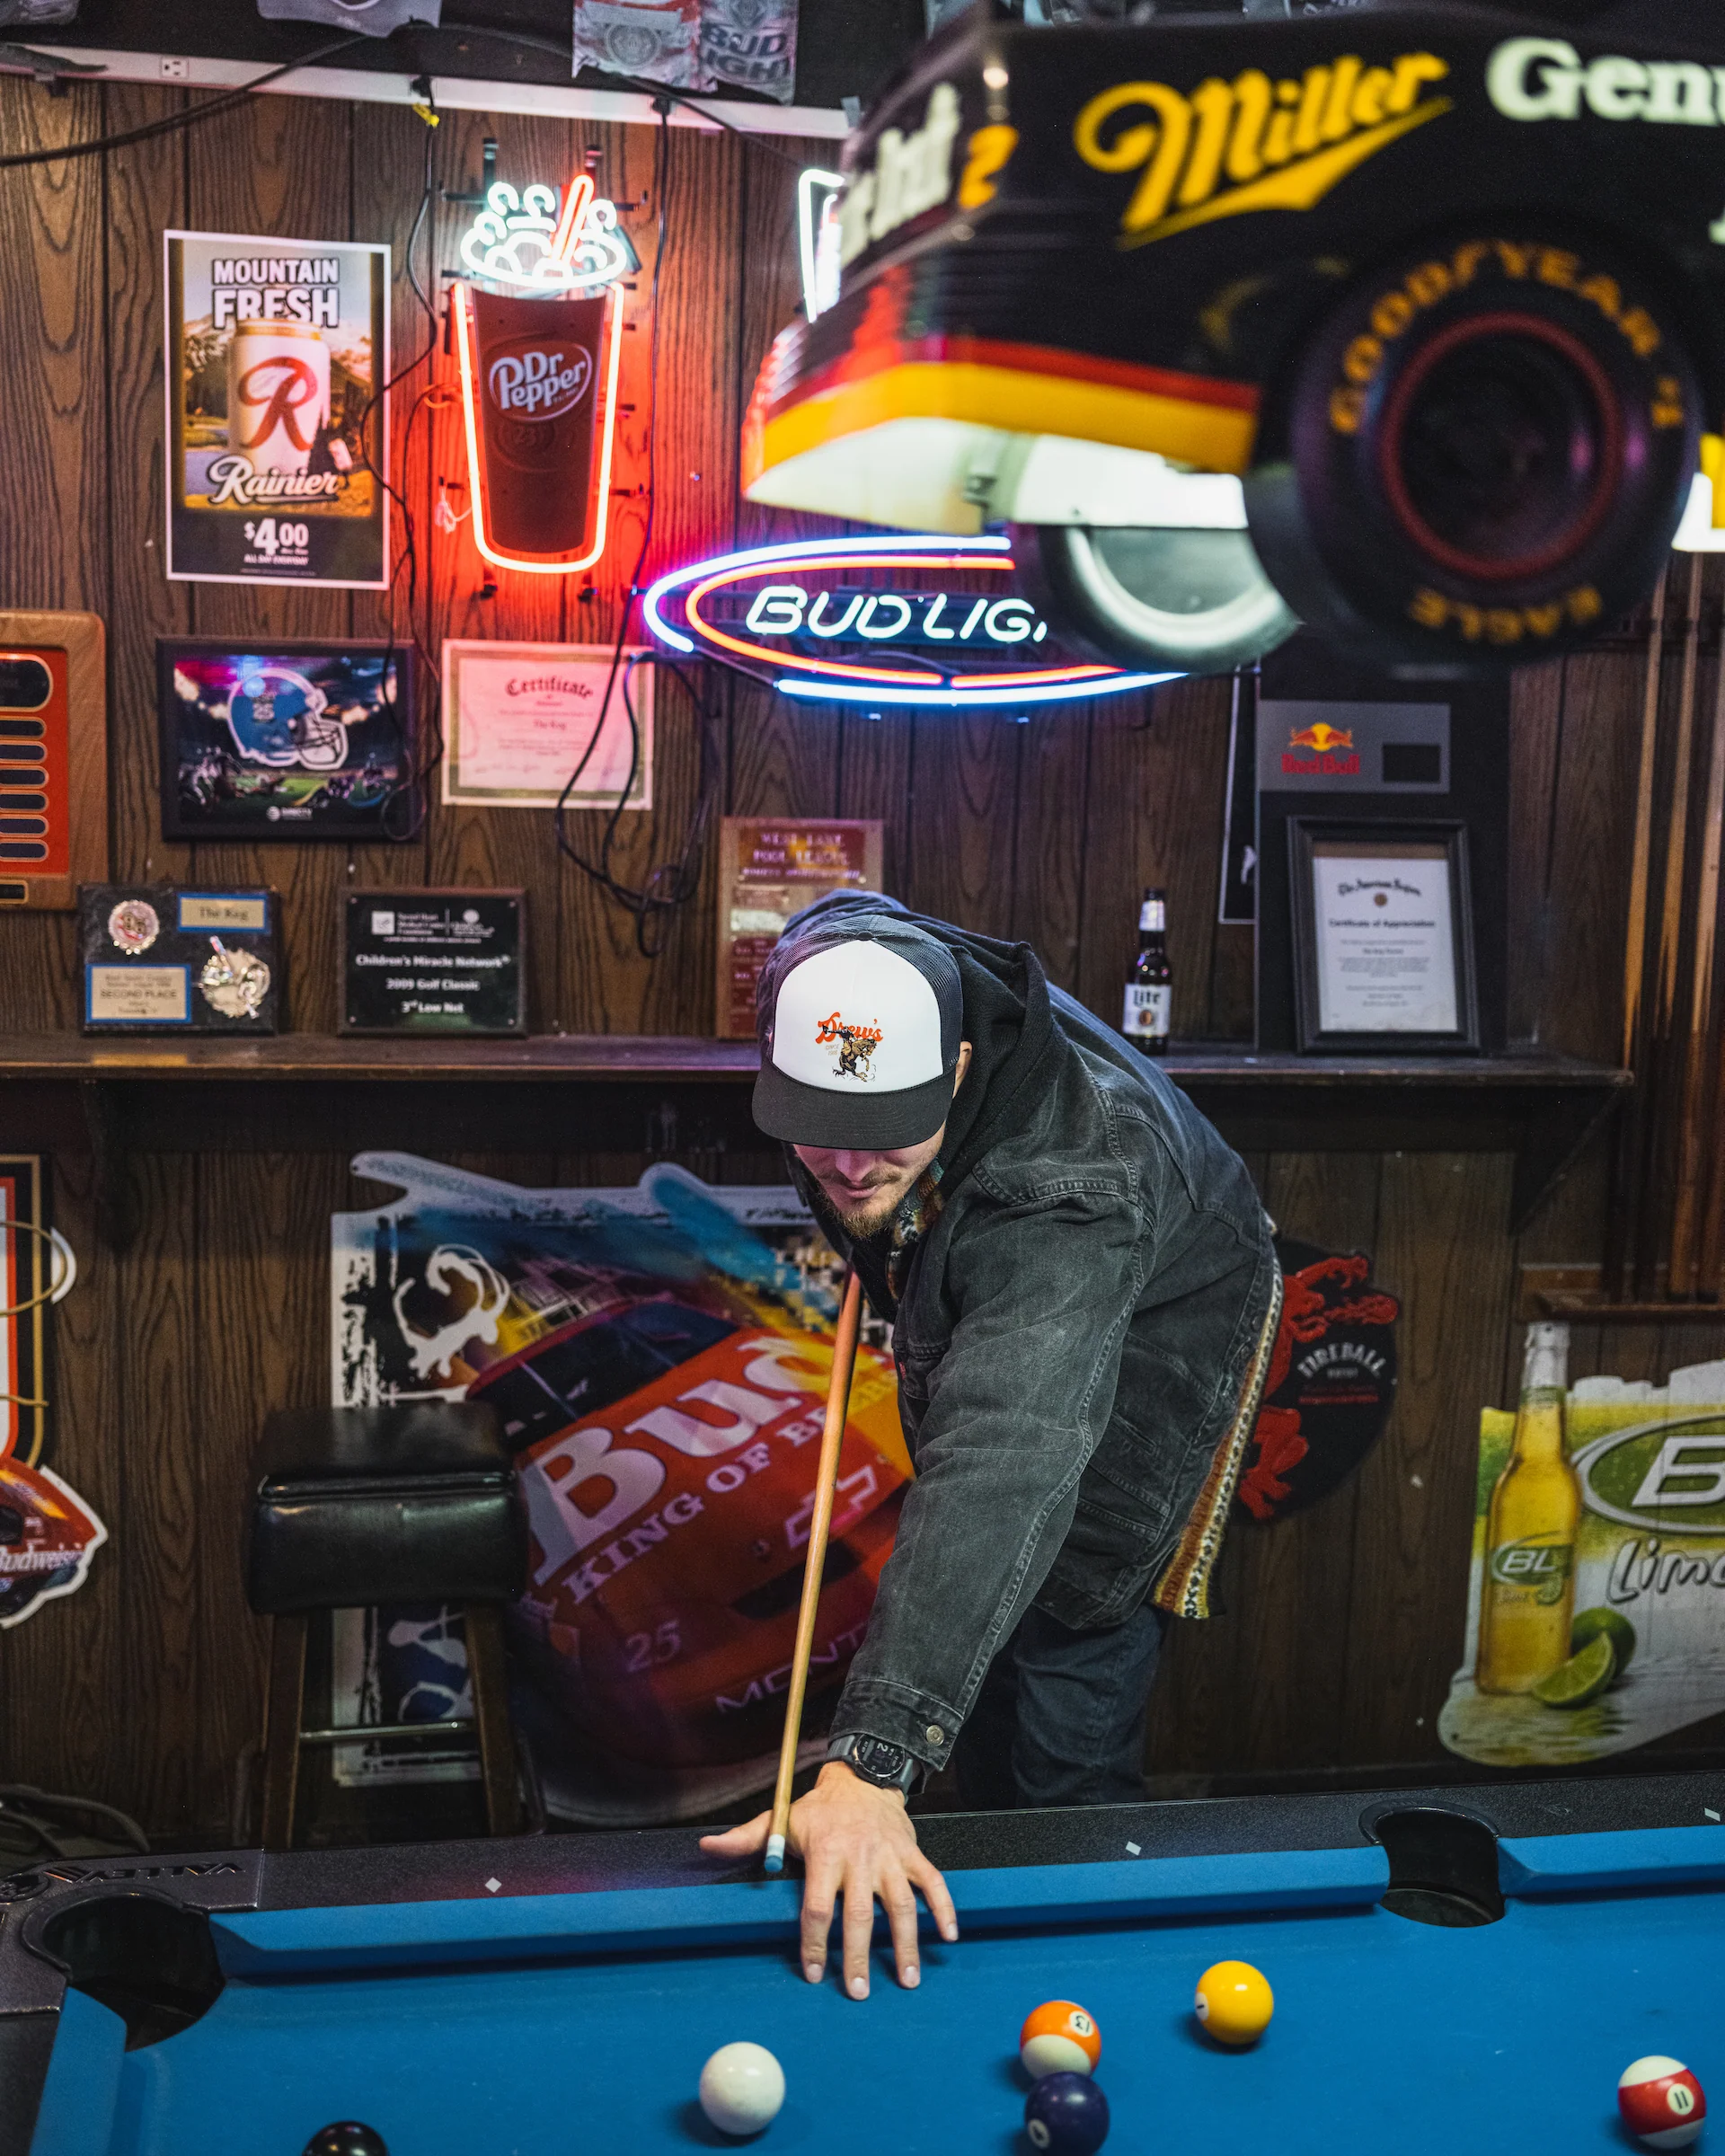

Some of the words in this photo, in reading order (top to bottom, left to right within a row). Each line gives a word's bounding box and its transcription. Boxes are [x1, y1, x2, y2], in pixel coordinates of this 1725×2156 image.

[1486, 36, 1725, 127] Gen
[1074, 51, 1450, 235] Miller
[212, 258, 340, 285] MOUNTAIN
[212, 287, 340, 329] FRESH
[524, 351, 564, 384] Dr
[490, 357, 586, 412] Pepper
[206, 454, 339, 505] Rainier
[746, 585, 911, 639] BUD
[923, 592, 1047, 642] LIG
[505, 675, 594, 702] Certificate
[1282, 754, 1320, 774] Red
[1322, 754, 1360, 774] Bull
[356, 954, 411, 967] Children's
[413, 955, 454, 967] Miracle
[416, 978, 440, 990] Golf
[1134, 990, 1161, 1006] Lite
[815, 1012, 883, 1044] Drew's
[562, 1493, 704, 1605] KING
[706, 1443, 771, 1494] OF
[1502, 1549, 1555, 1573] BL
[625, 1620, 680, 1674] 25
[1075, 2014, 1091, 2034] 13
[1673, 2090, 1689, 2110] 11
